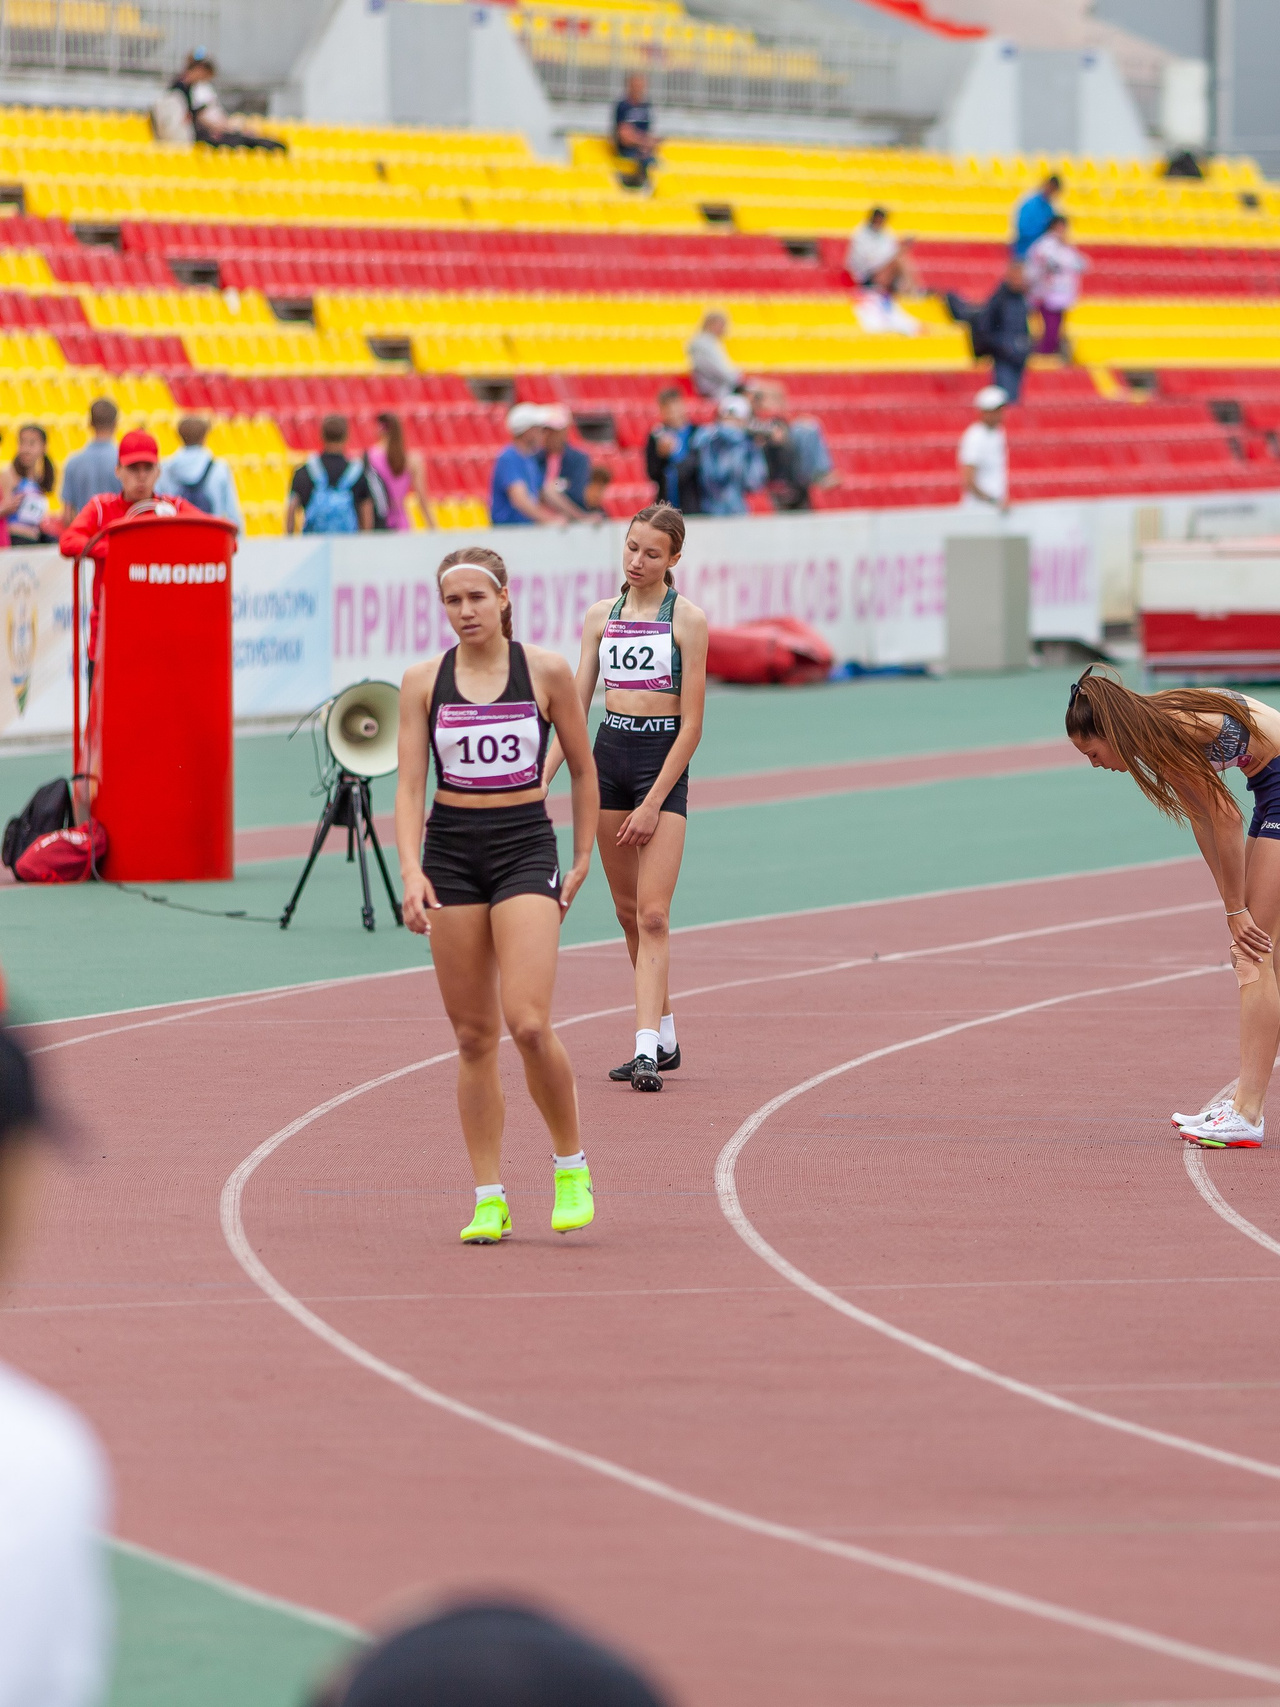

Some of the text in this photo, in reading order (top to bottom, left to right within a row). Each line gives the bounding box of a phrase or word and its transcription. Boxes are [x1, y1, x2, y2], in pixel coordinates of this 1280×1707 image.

[148, 561, 227, 584] MONDO
[609, 645, 655, 670] 162
[603, 713, 676, 732] VERLATE
[456, 734, 521, 764] 103
